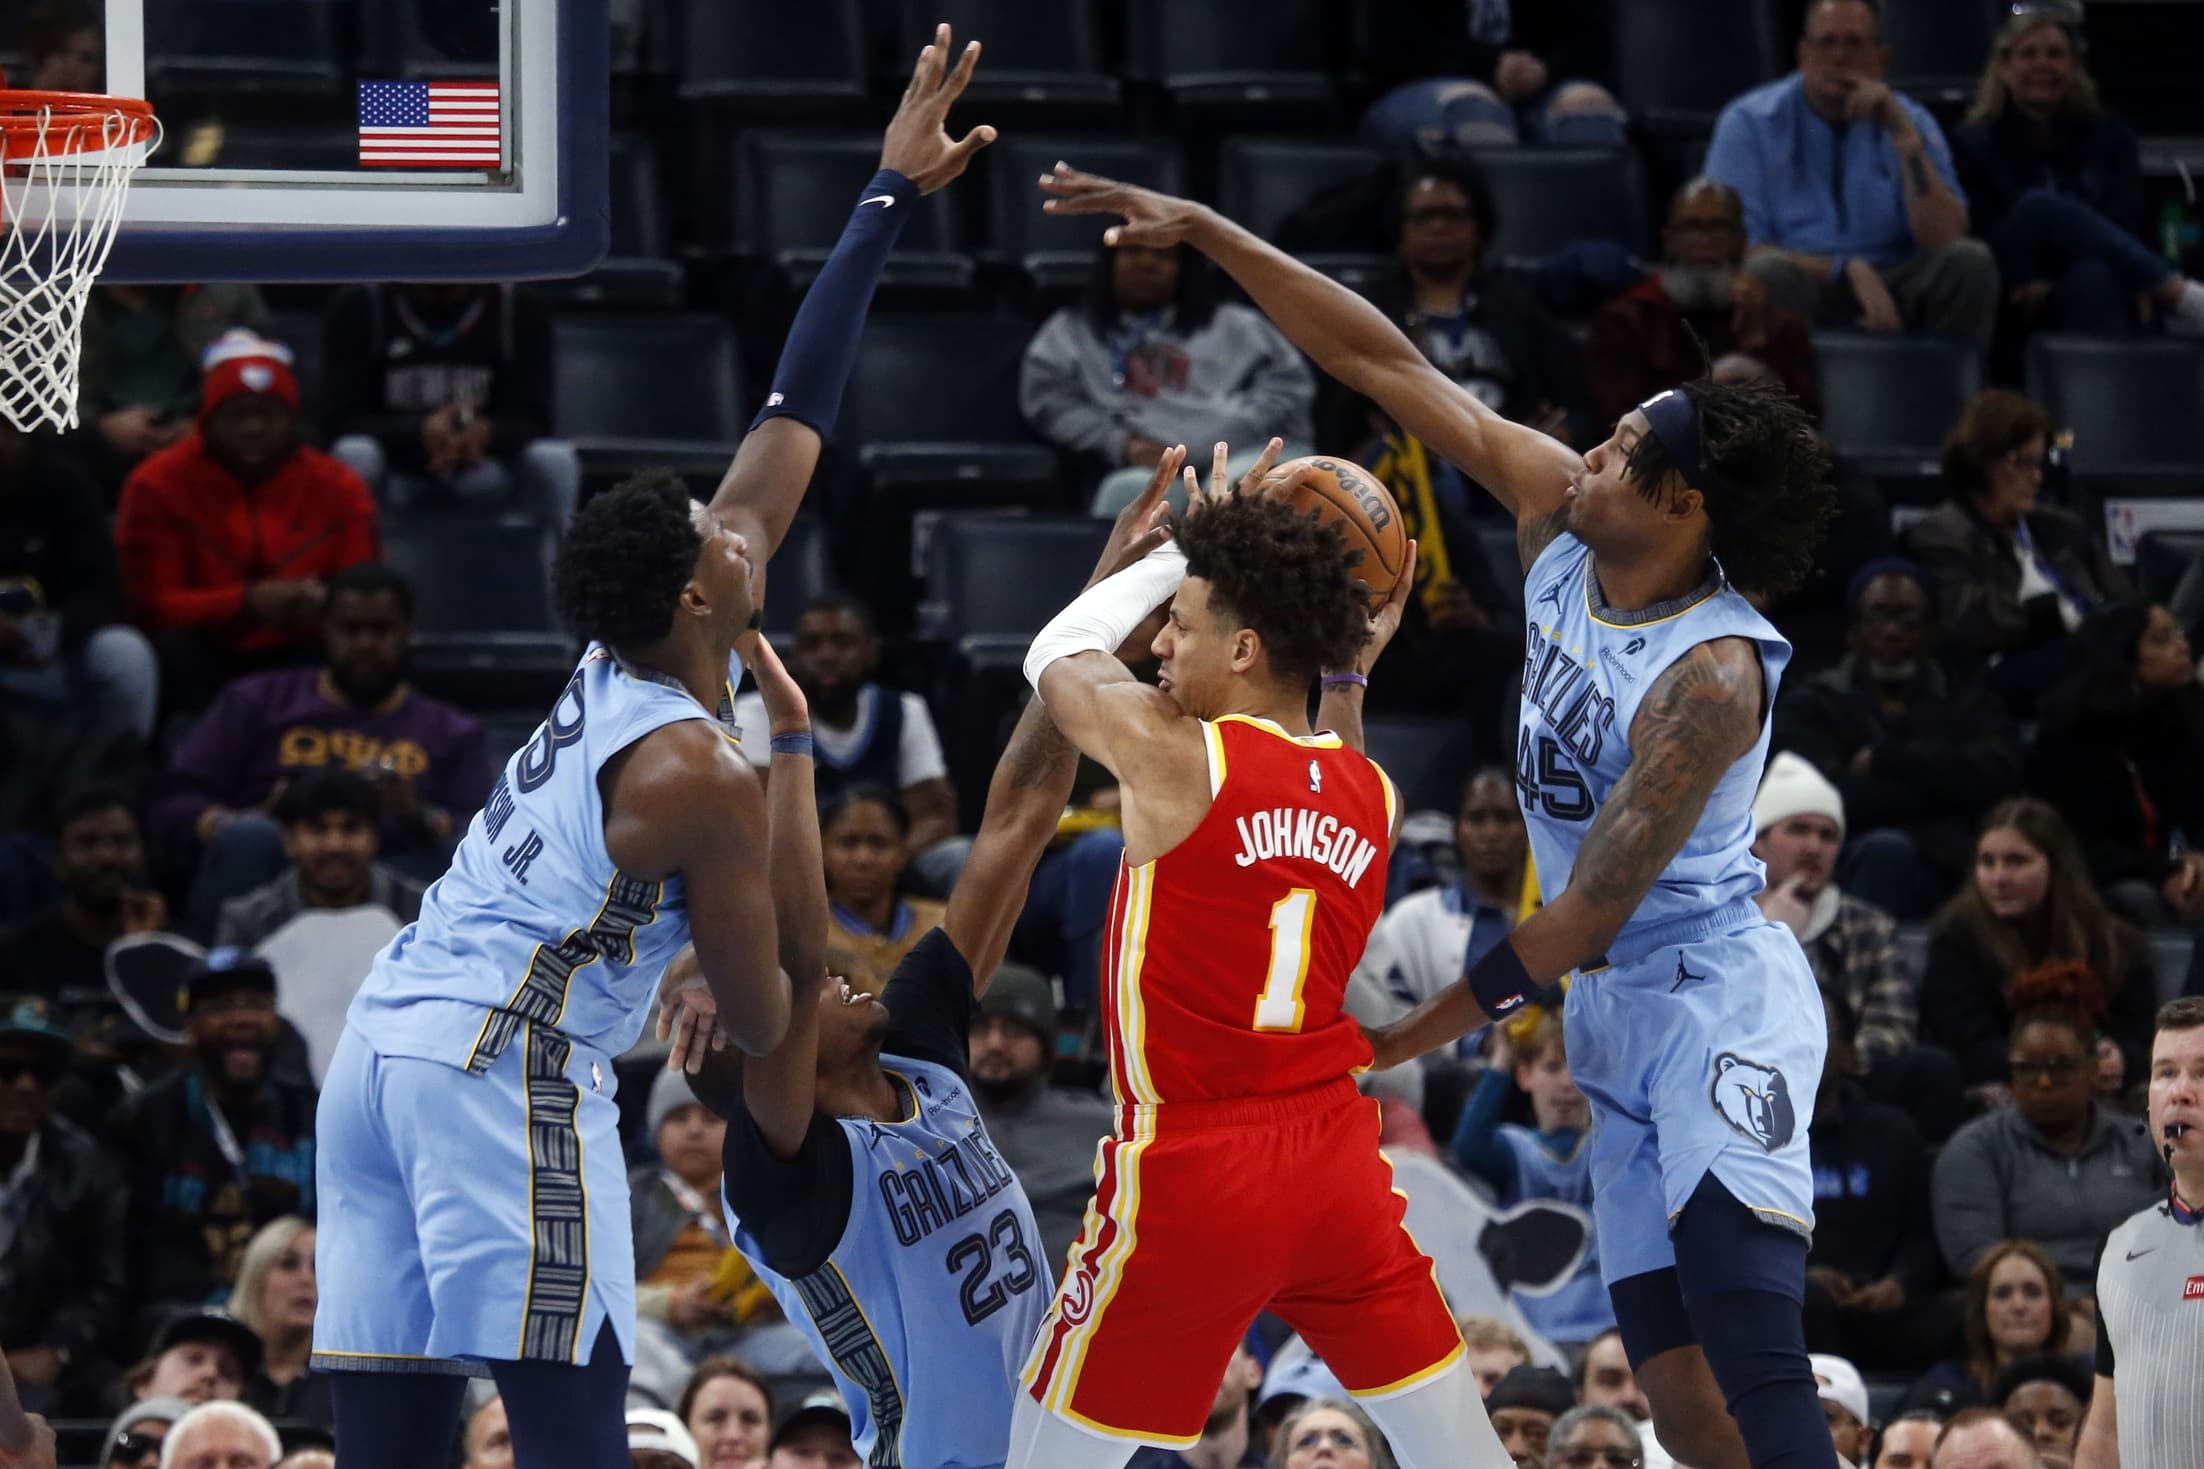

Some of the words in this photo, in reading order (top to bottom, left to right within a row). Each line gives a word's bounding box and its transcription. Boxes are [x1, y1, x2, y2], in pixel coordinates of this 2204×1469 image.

[516, 667, 585, 794] 8
[1516, 724, 1595, 821] 45
[503, 829, 545, 886] JR.
[1235, 808, 1377, 888] JOHNSON
[1253, 887, 1317, 1034] 1
[946, 1208, 1036, 1327] 23
